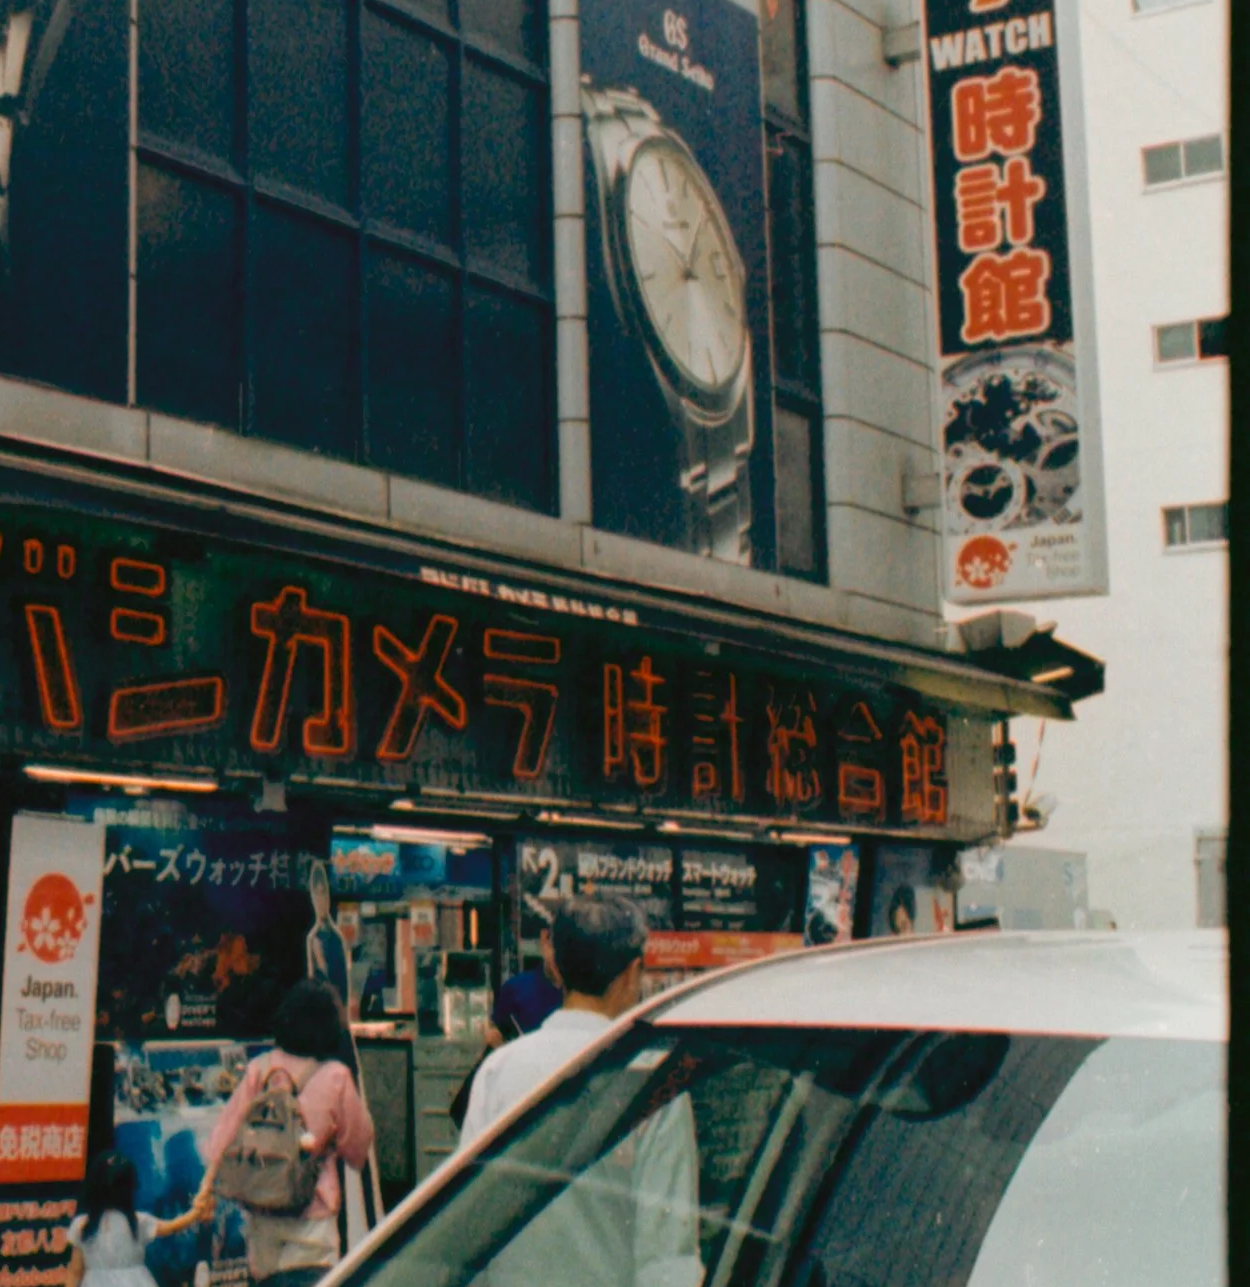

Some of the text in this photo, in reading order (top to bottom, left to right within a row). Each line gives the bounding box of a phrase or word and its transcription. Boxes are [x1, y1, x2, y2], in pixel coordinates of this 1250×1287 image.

[664, 9, 689, 50] GS
[930, 13, 1052, 71] WATCH
[952, 66, 1050, 344] 時計館
[602, 654, 948, 825] 時計総合館
[20, 975, 79, 1003] Japan.
[17, 1009, 82, 1031] Tax-free
[25, 1036, 68, 1063] Shop
